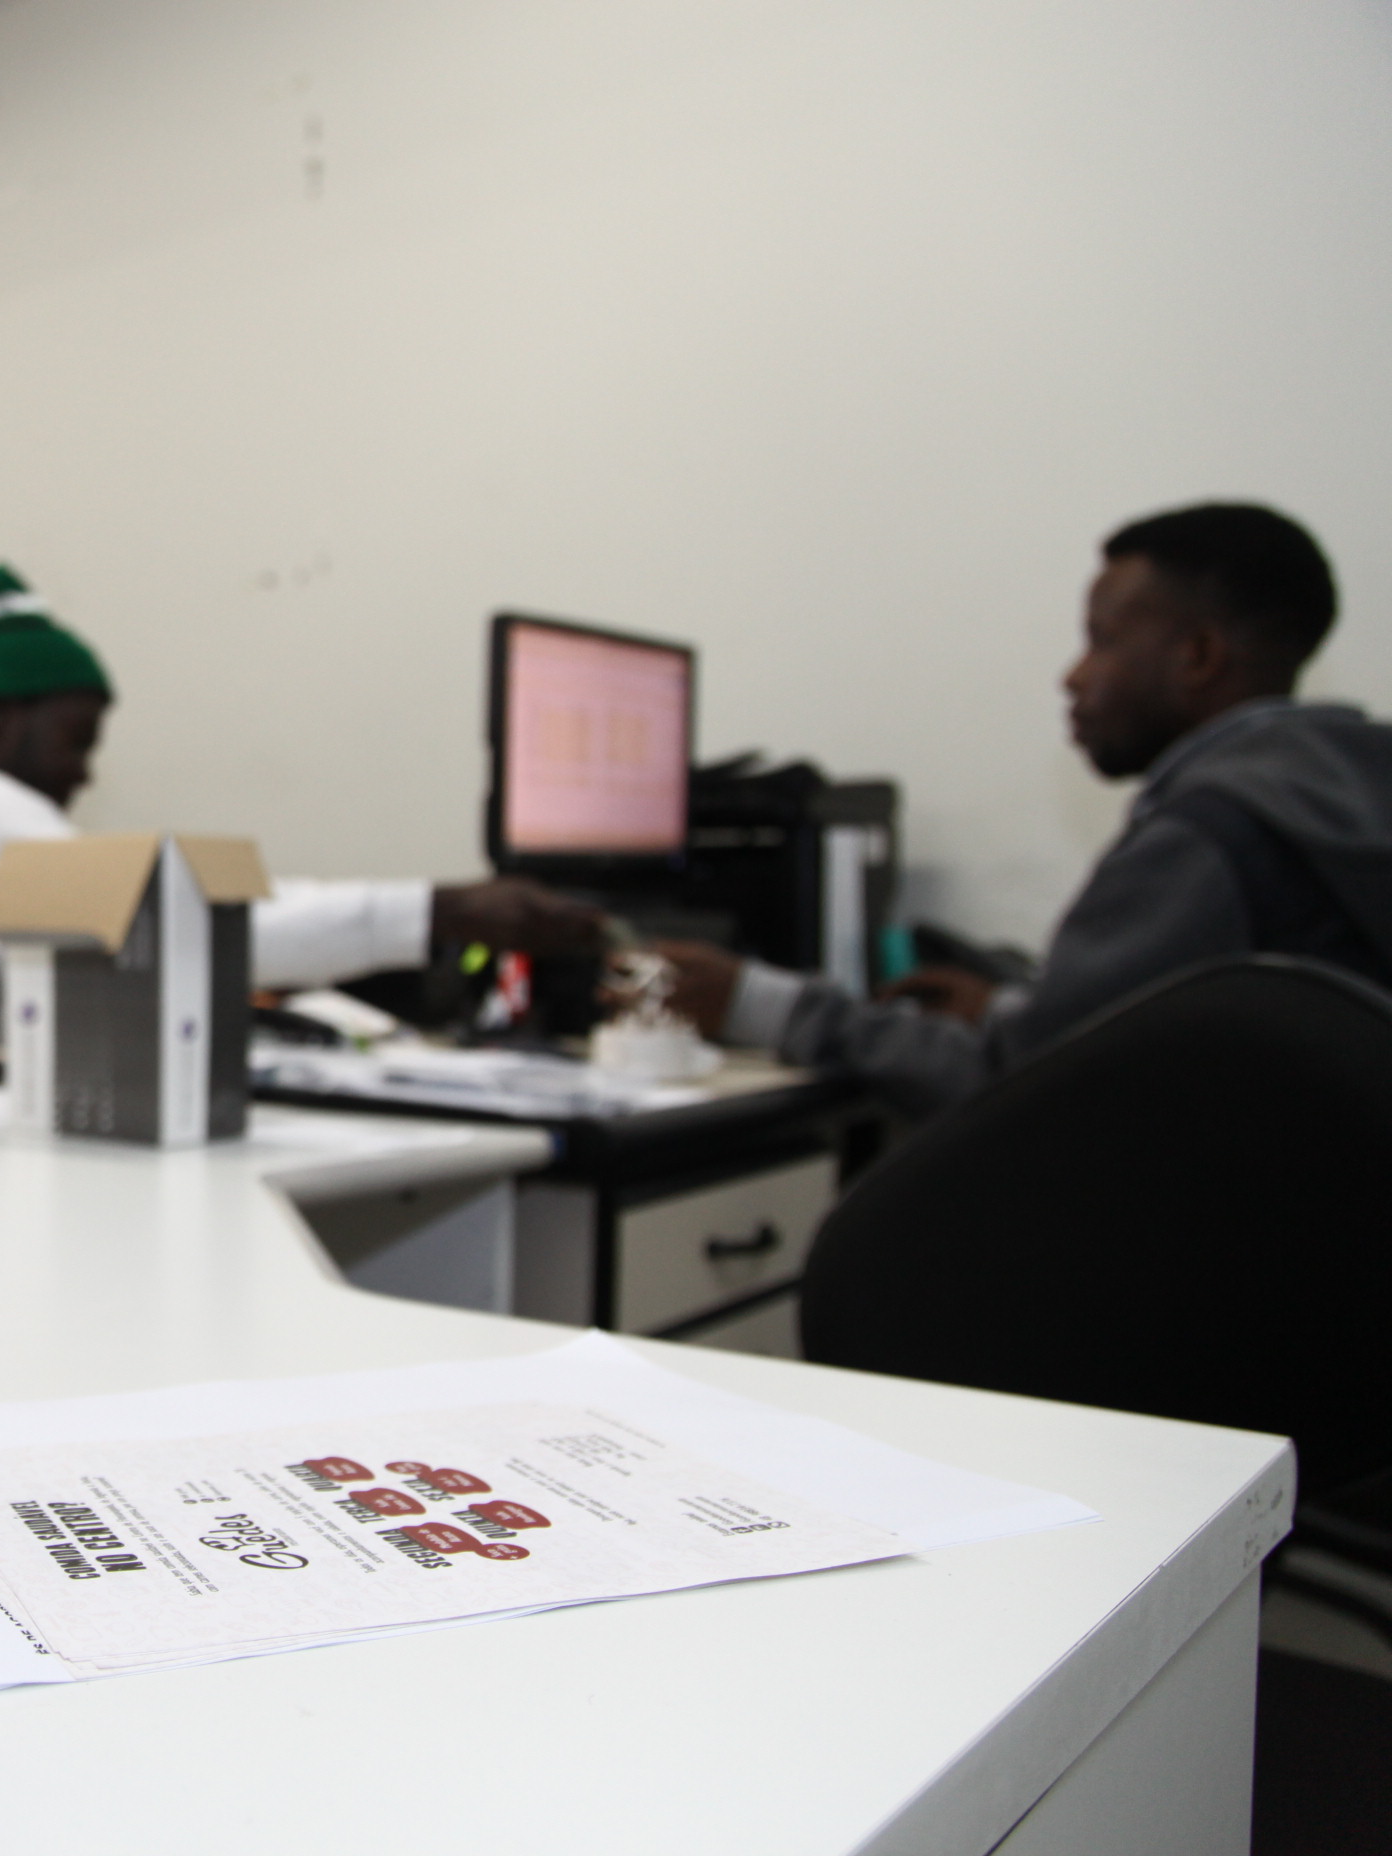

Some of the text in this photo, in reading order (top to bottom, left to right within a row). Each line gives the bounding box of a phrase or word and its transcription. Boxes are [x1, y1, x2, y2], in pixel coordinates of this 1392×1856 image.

[10, 1500, 66, 1541] SAUDÁVEL
[47, 1502, 125, 1550] CENTRO?
[451, 1508, 517, 1539] QUINTA
[45, 1542, 101, 1580] COMIDA
[209, 1513, 309, 1570] Guedes
[375, 1527, 453, 1569] SEGUNDA
[95, 1553, 147, 1572] NO
